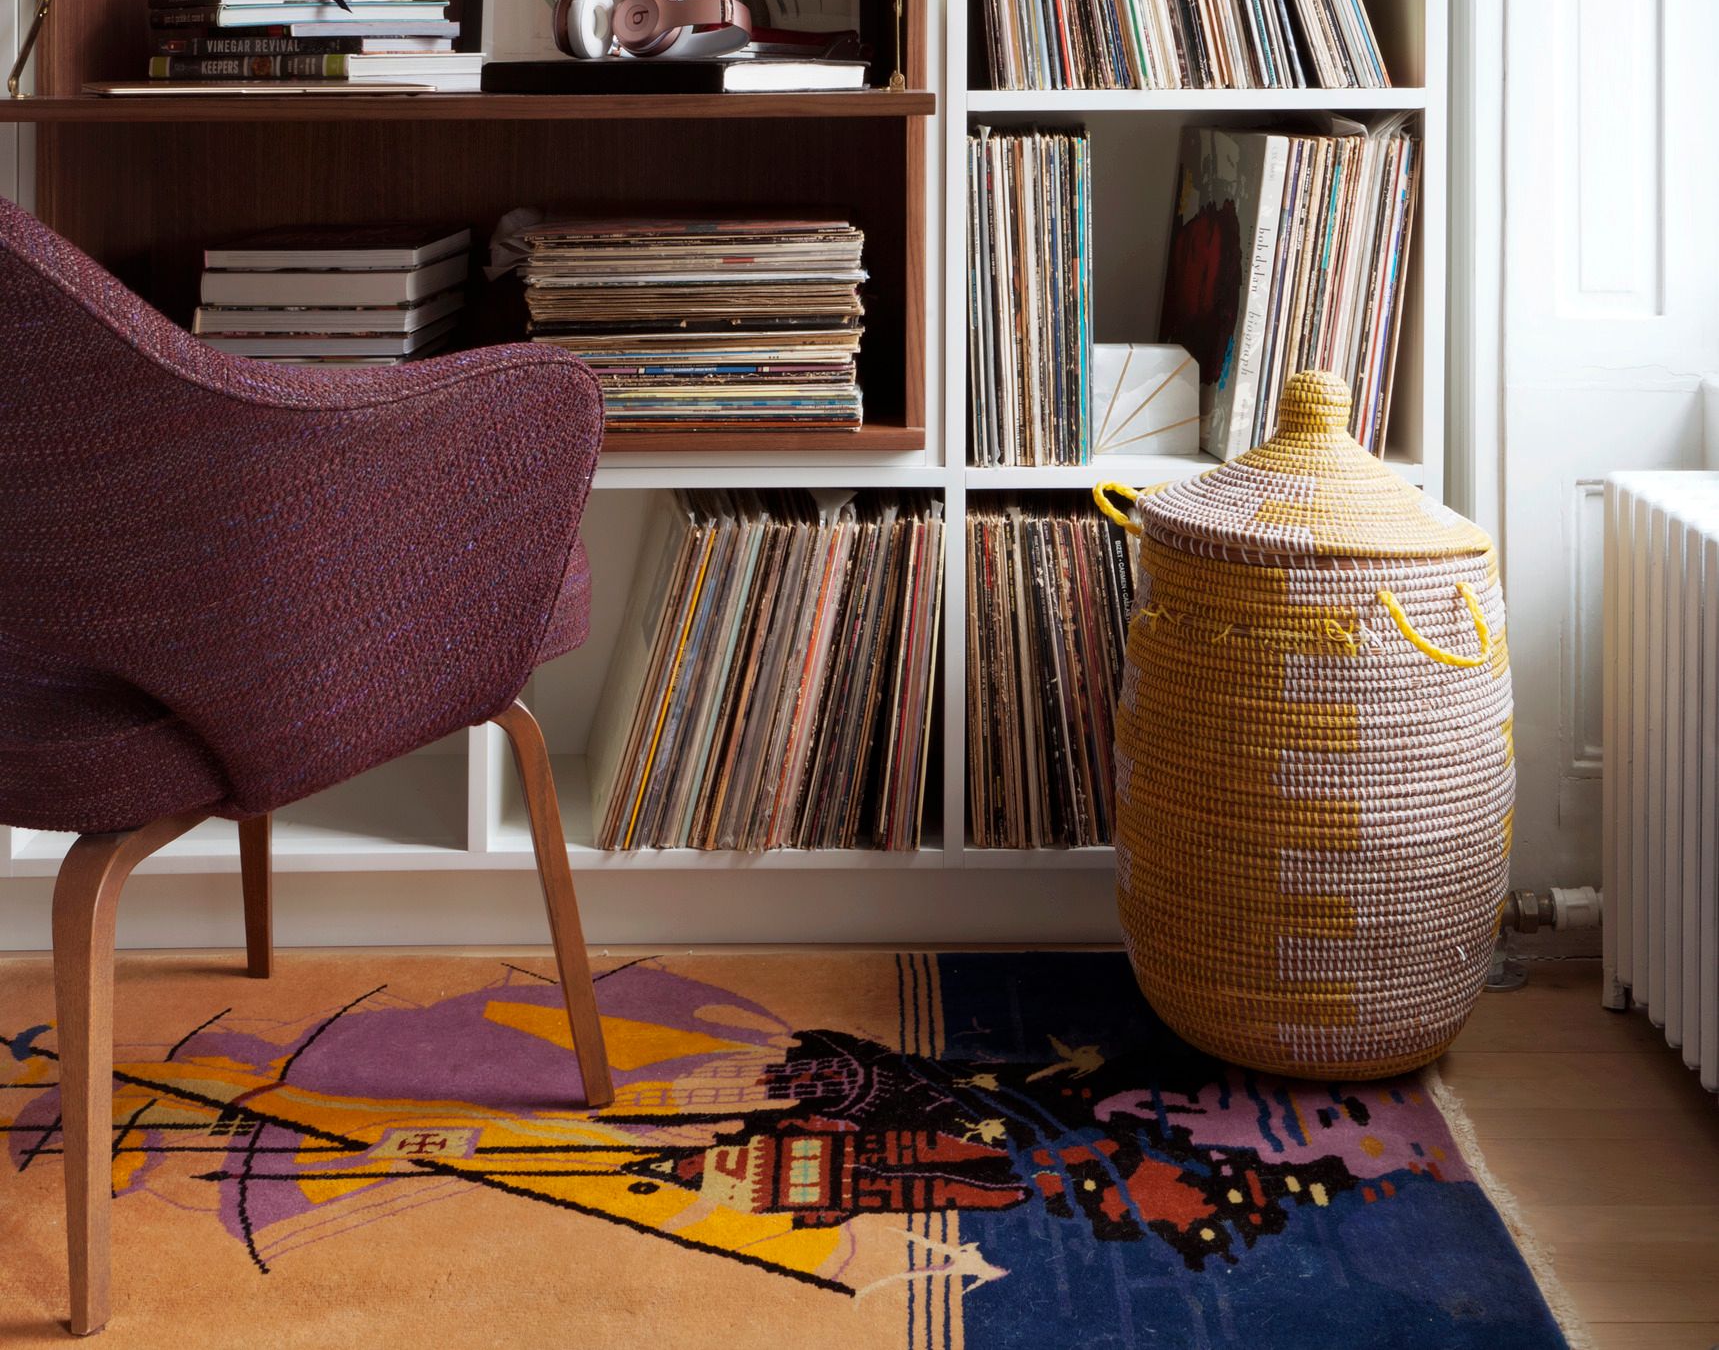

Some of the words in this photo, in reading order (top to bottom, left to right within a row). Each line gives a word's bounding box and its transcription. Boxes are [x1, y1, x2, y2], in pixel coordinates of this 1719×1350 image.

[206, 38, 250, 54] VINEGAR
[255, 38, 301, 53] REVIVAL
[200, 60, 240, 75] KEEPERS
[1256, 227, 1271, 251] bob
[1251, 255, 1268, 293] dylan
[1240, 310, 1261, 377] biograph
[1114, 540, 1122, 559] BIZET
[1118, 561, 1127, 590] CARMEN
